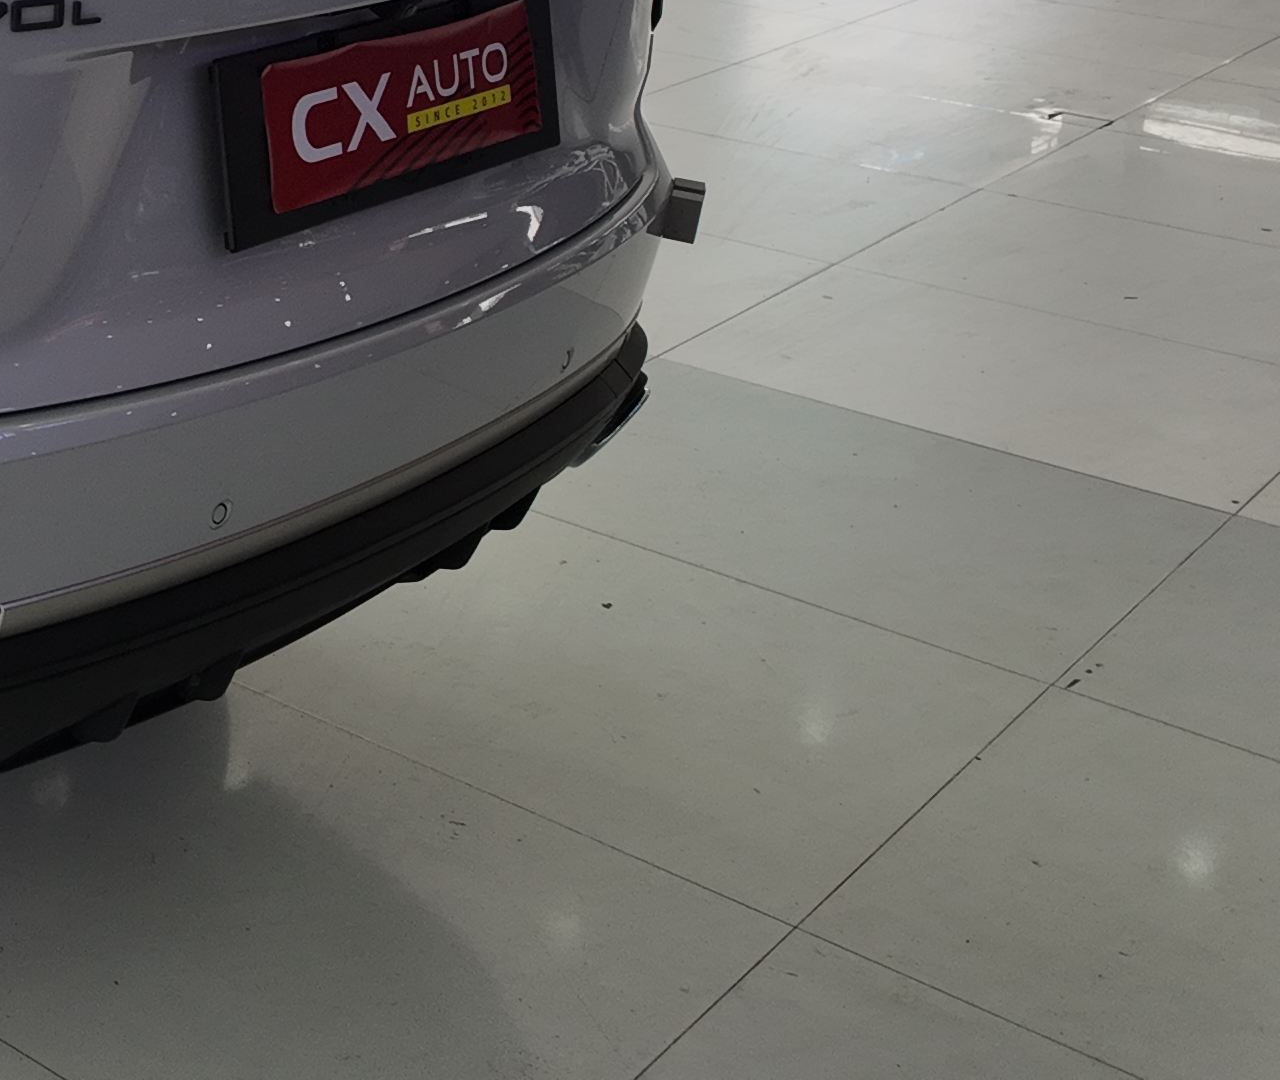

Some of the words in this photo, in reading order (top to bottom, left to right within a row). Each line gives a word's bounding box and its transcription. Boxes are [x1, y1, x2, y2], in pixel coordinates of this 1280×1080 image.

[290, 72, 398, 164] CX
[405, 40, 509, 109] AUTO
[413, 102, 464, 129] SINCE
[472, 90, 510, 112] 2012
